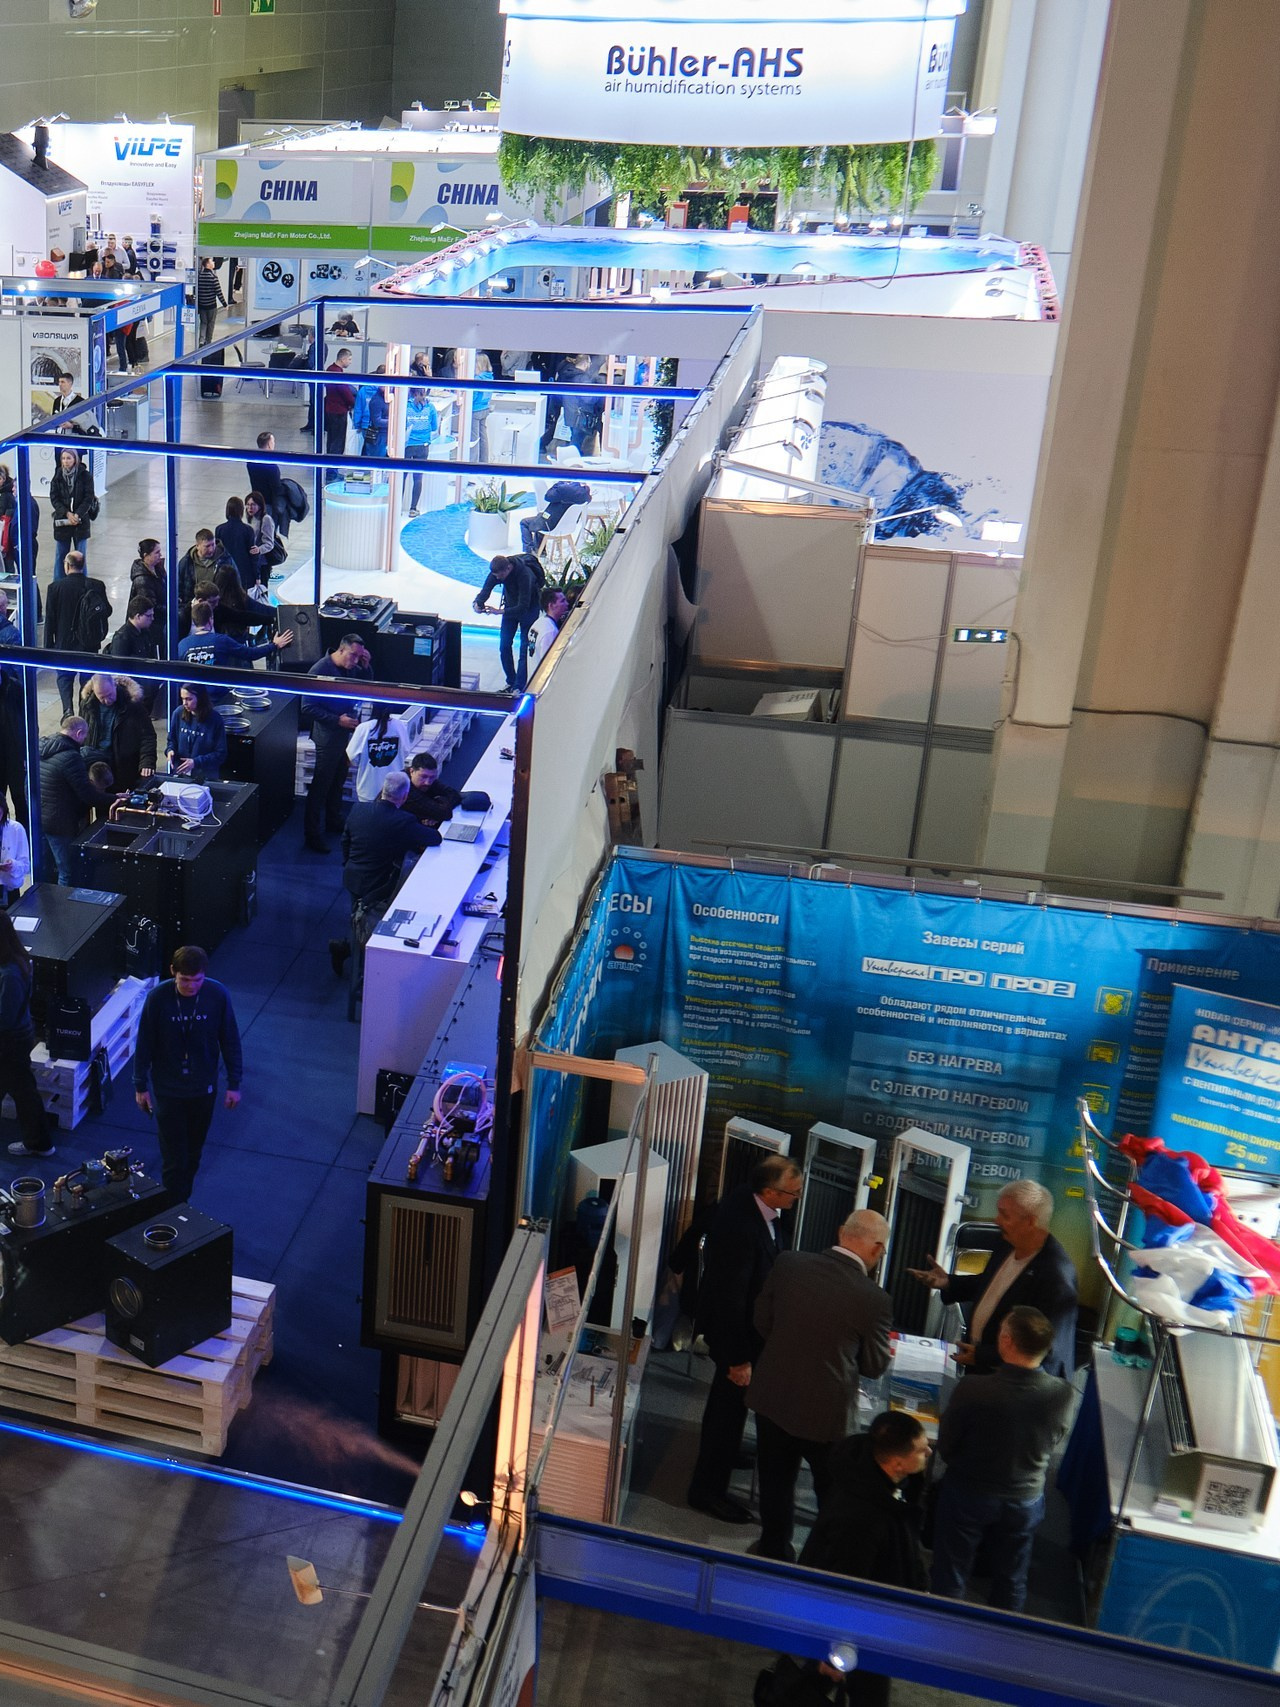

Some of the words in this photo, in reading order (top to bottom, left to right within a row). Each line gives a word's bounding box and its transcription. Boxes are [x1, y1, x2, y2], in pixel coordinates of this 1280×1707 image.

[606, 45, 804, 78] Bühler-AHS
[604, 80, 621, 93] air
[625, 79, 737, 96] humidification
[740, 81, 802, 98] systems
[113, 136, 183, 161] VILPE
[260, 179, 318, 201] CHINA
[437, 183, 499, 205] CHINA
[233, 231, 260, 240] Zhejiang
[261, 231, 276, 239] MaEr
[277, 231, 289, 239] Fan
[409, 235, 436, 244] Zhejiang
[437, 235, 454, 243] MaEr
[692, 903, 780, 925] Особенности
[922, 930, 978, 950] Завесы
[981, 938, 1025, 955] серий
[702, 955, 733, 965] скорости
[733, 958, 758, 968] потока
[758, 961, 768, 969] 20
[1147, 957, 1241, 981] Применение
[929, 966, 984, 985] ПРО
[880, 995, 932, 1013] Обладают
[935, 1003, 966, 1017] рядом
[969, 1007, 1047, 1026] отличительных
[1195, 1007, 1231, 1024] НОВАЯ
[55, 1028, 82, 1037] TURKOV
[857, 1005, 926, 1024] особенностей
[929, 1016, 935, 1024] и
[937, 1017, 1004, 1035] исполняются
[1006, 1026, 1012, 1035] в
[1015, 1027, 1068, 1041] вариантах
[907, 1049, 934, 1065] БЕЗ
[938, 1054, 1003, 1075] НАГРЕВА
[871, 1079, 880, 1092] С
[883, 1080, 949, 1102] ЭЛЕКТРО
[952, 1091, 1029, 1114] НАГРЕВОМ
[863, 1112, 871, 1124] С
[953, 1125, 1030, 1149] НАГРЕВОМ
[1225, 1141, 1247, 1159] 25
